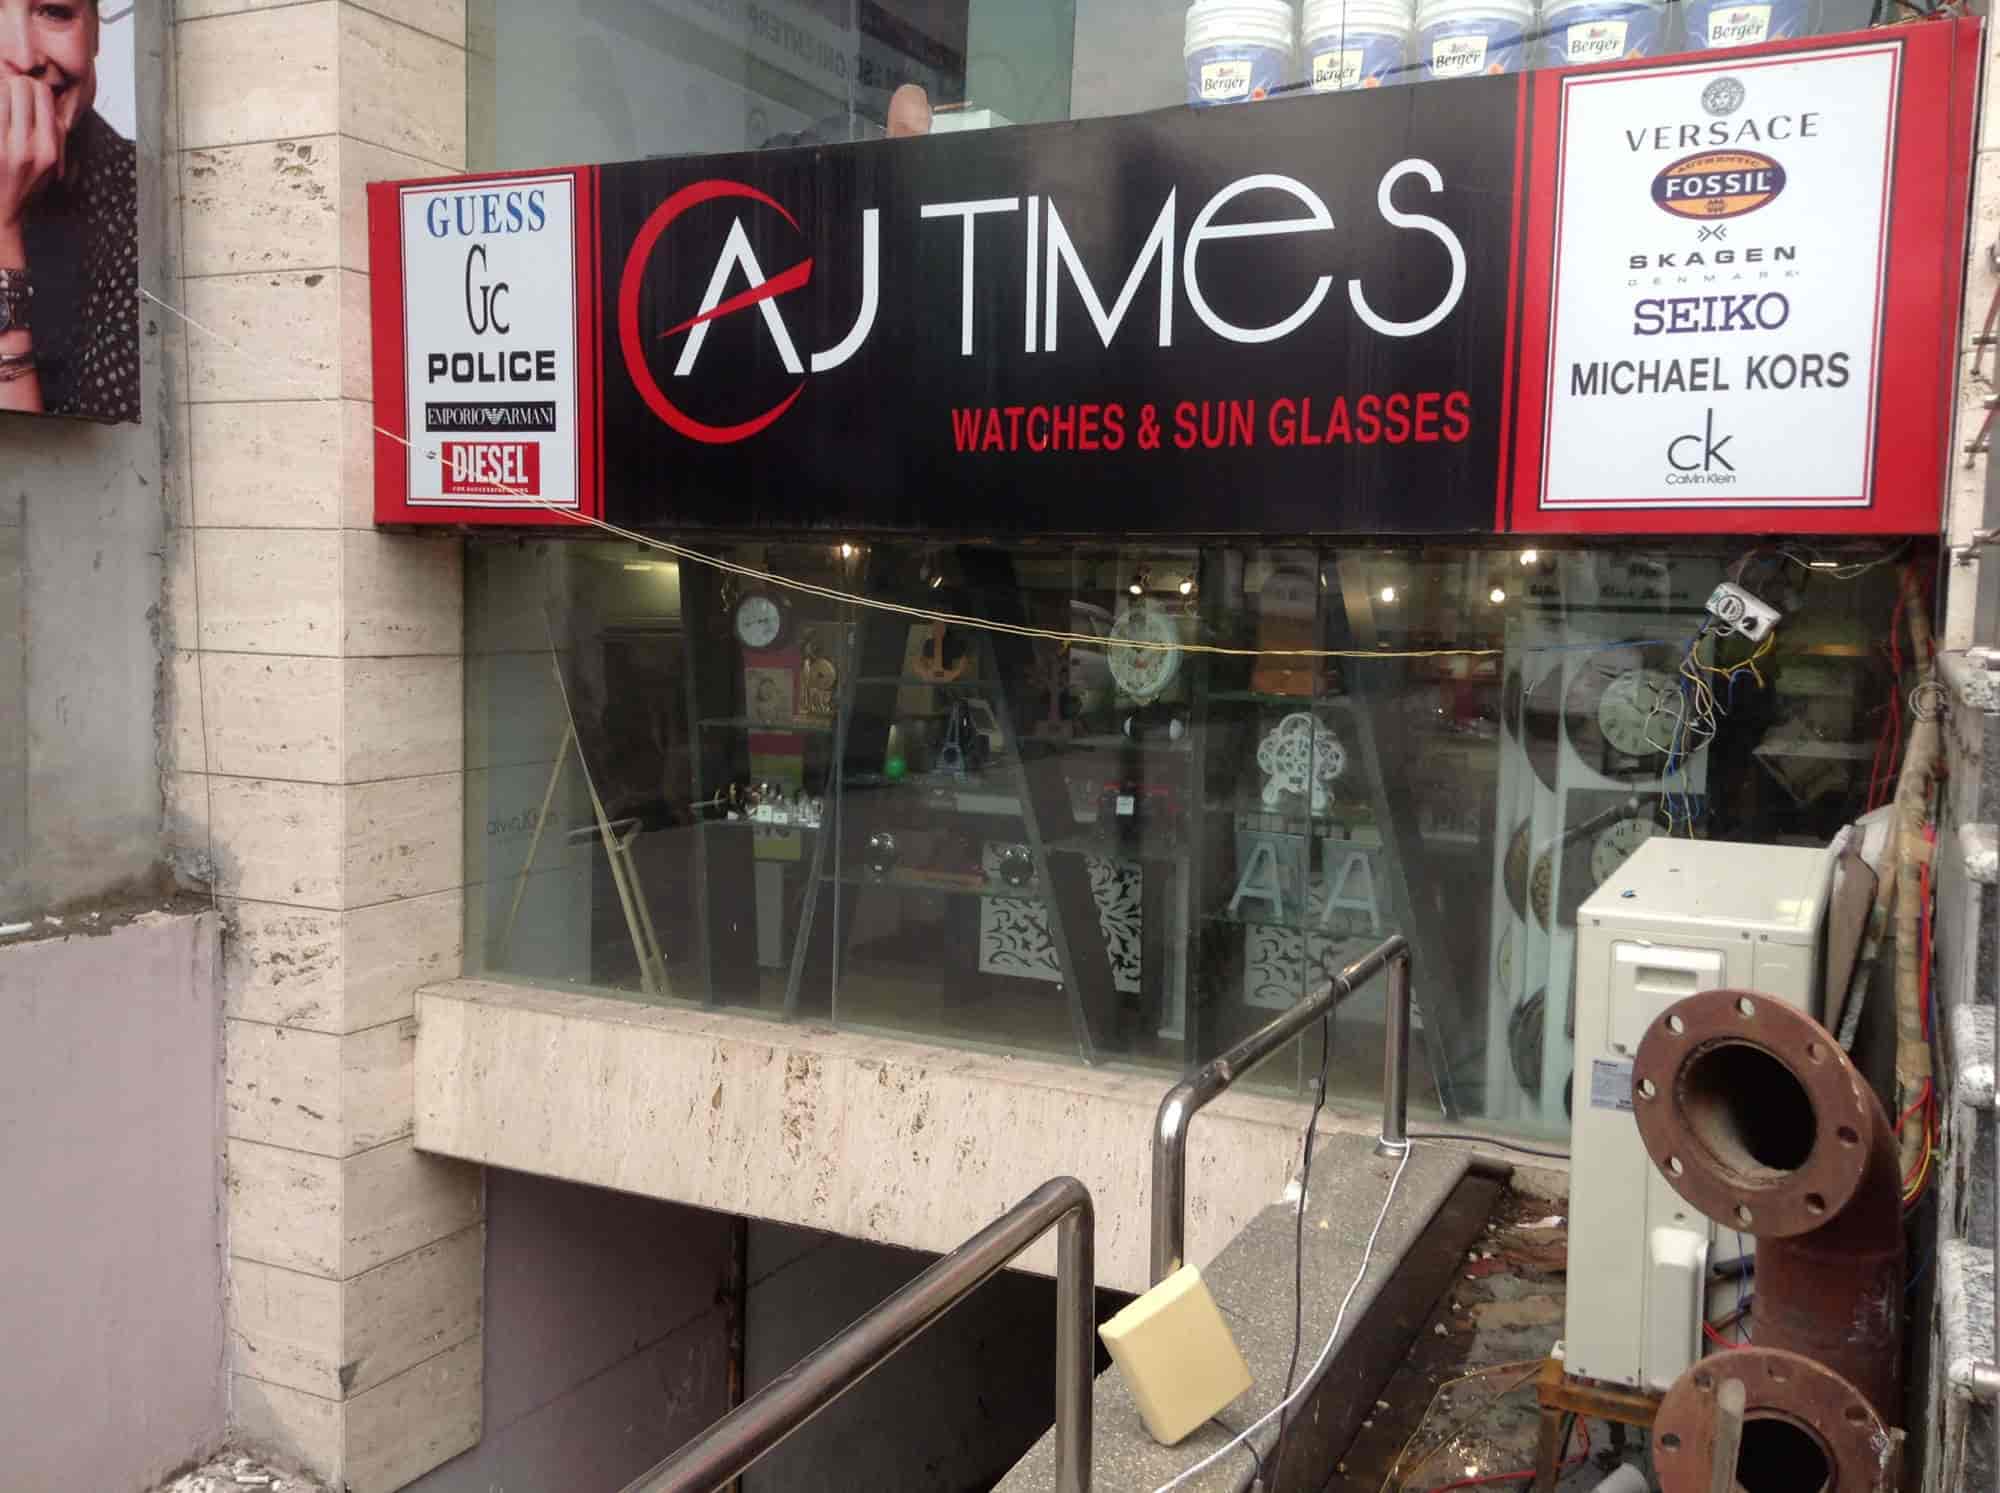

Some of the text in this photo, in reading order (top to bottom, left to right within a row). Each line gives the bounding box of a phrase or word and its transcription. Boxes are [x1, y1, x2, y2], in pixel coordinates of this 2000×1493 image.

[1711, 22, 1764, 41] Berger
[1571, 38, 1619, 54] Berger
[1435, 52, 1481, 69] Berger
[1204, 77, 1245, 92] Berger
[1625, 112, 1820, 152] VERSACE
[1665, 172, 1771, 198] FOSSIL
[427, 190, 546, 238] GUESS
[1629, 245, 1796, 269] SKAGEN
[1633, 292, 1789, 335] SEIKO
[428, 350, 556, 384] POLICE
[1571, 352, 1850, 396] MICHAEL KORS
[427, 407, 554, 425] EMPORIO ARMANI
[951, 391, 1472, 452] WATCHES & SUN GLASSES
[452, 444, 529, 484] DIESEL
[1665, 472, 1736, 485] Calvin Klein
